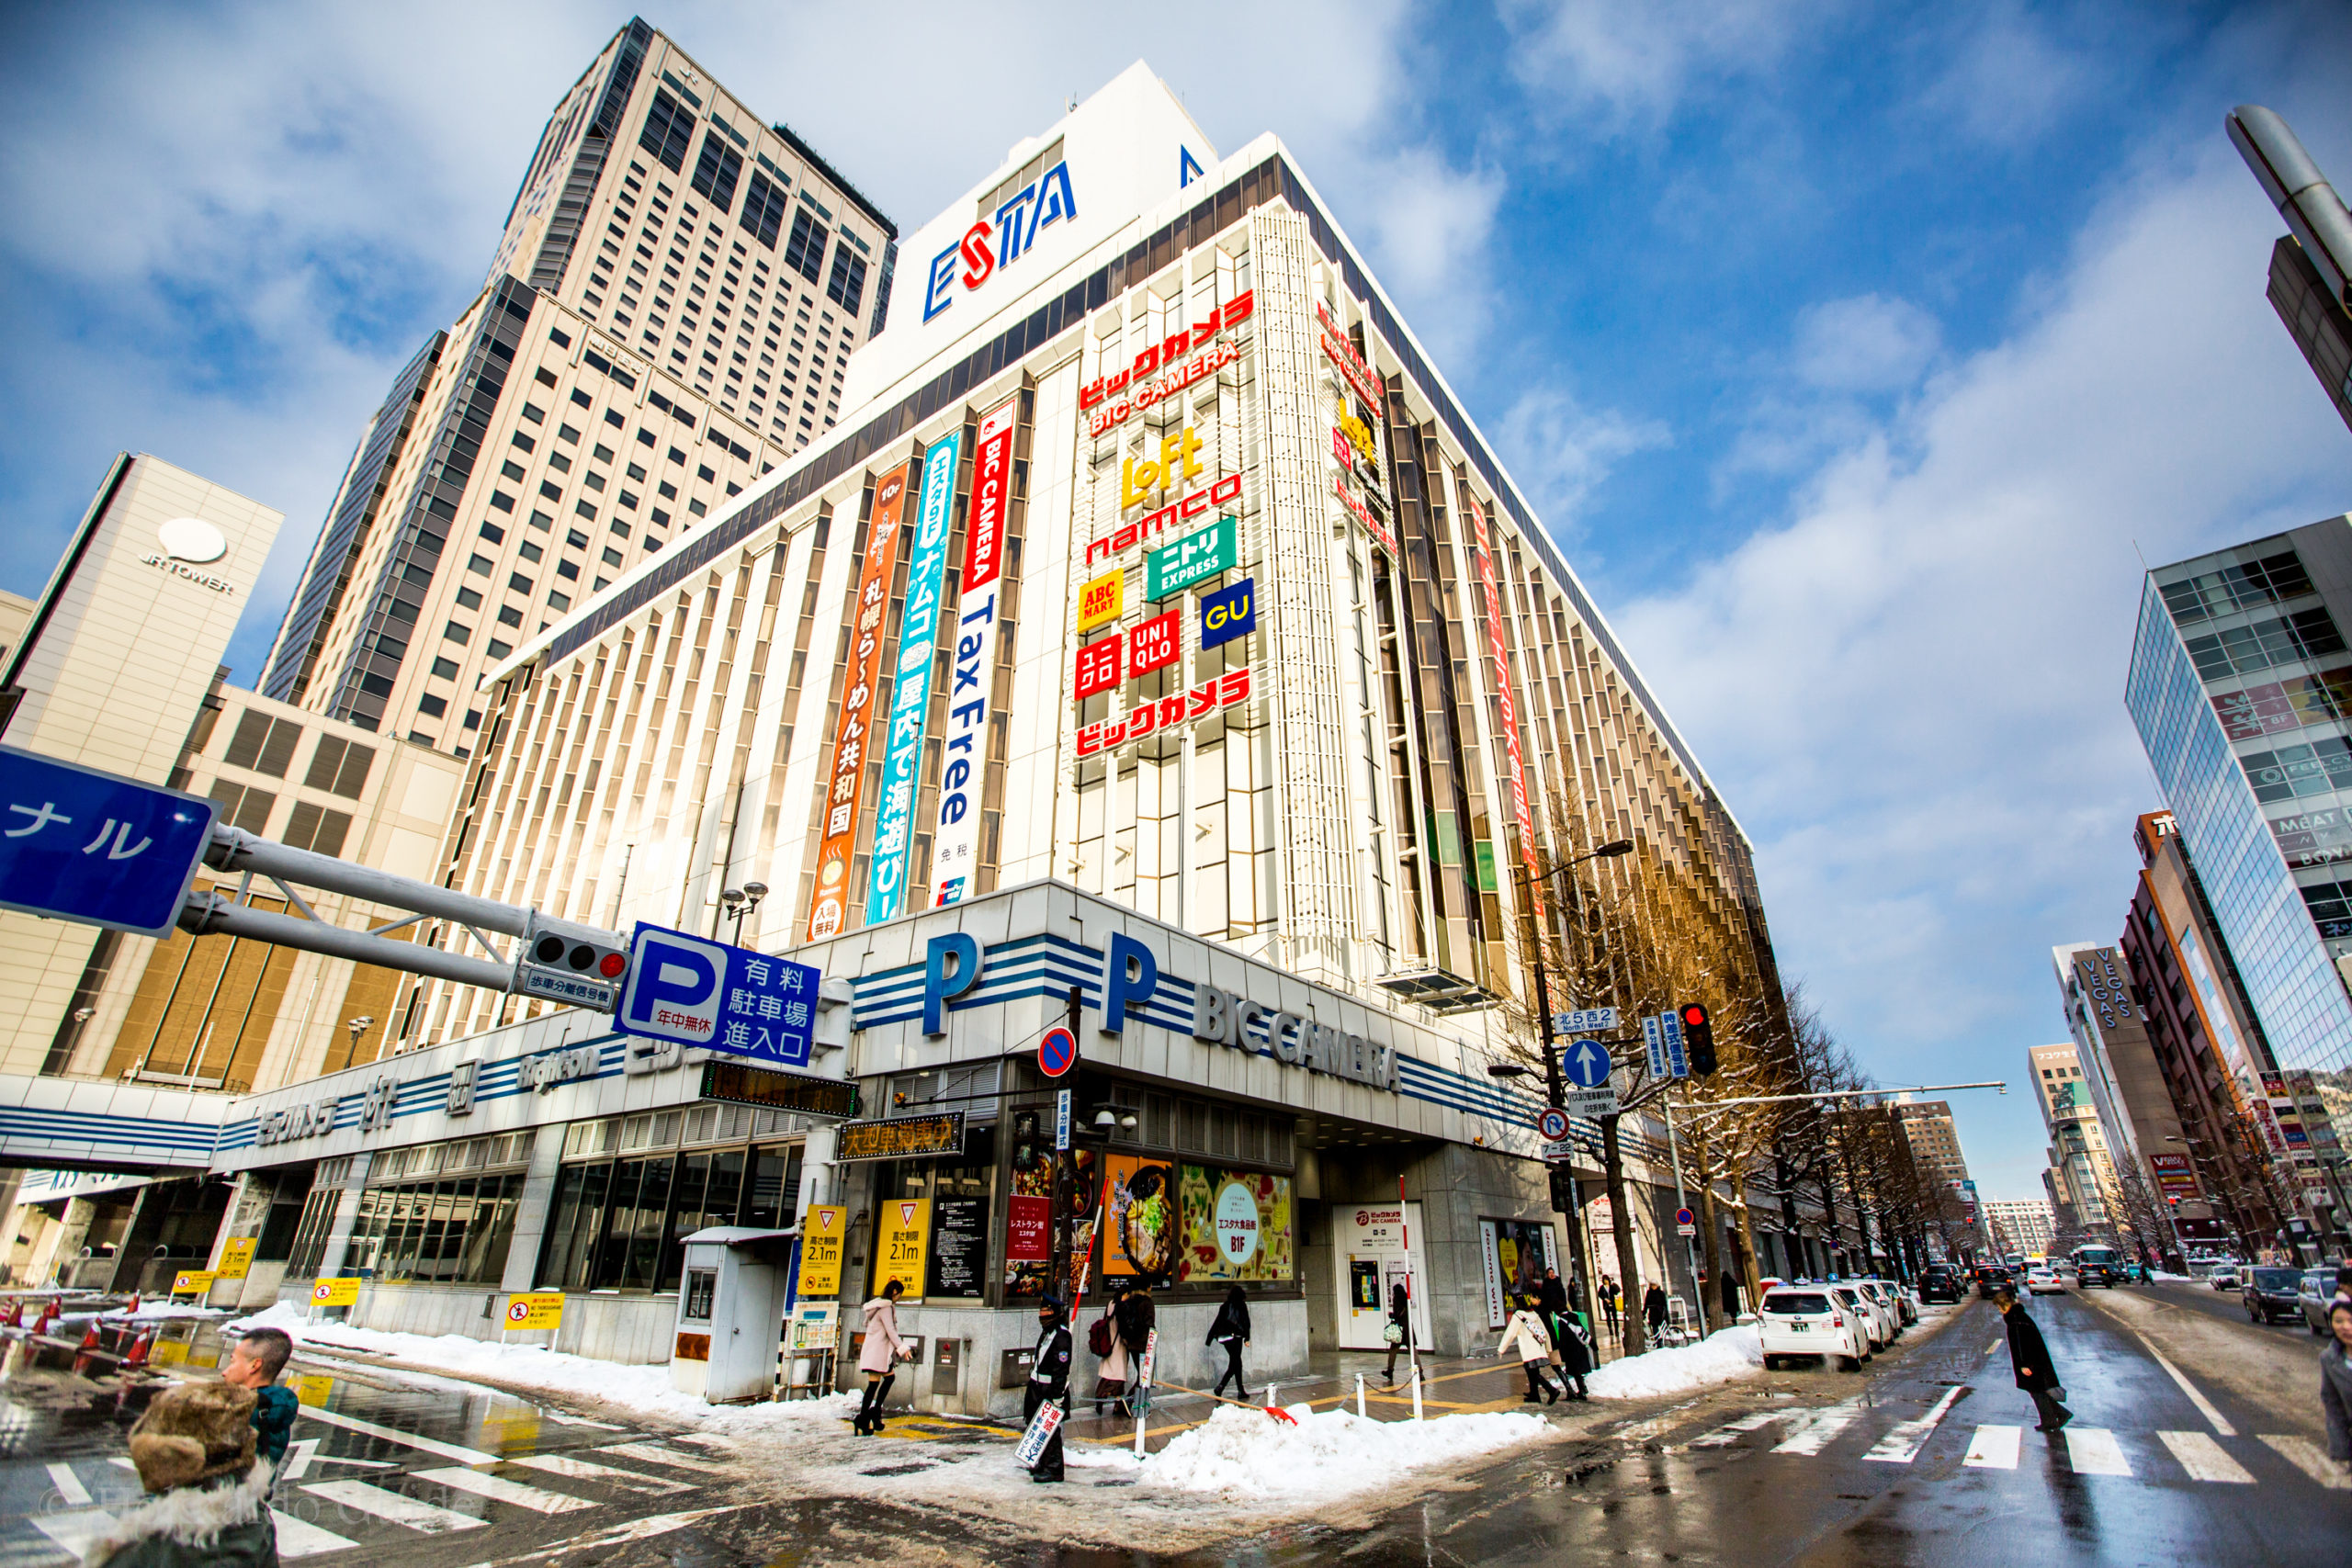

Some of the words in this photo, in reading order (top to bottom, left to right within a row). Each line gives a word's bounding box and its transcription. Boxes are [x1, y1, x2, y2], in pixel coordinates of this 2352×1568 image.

[922, 160, 1078, 324] ESTA
[1080, 288, 1254, 411] ビックカメラ
[1091, 400, 1131, 437] BIC
[1134, 340, 1240, 411] CAMERA
[983, 437, 1002, 479] BIC
[1334, 432, 1347, 453] UNI
[881, 483, 901, 502] 10F
[973, 480, 999, 583] CAMERA
[1086, 473, 1242, 566] namco
[1337, 478, 1397, 556] ビックカメラ
[1161, 527, 1219, 574] ニトリ
[139, 552, 167, 570] JR
[165, 558, 235, 596] TOWER
[1161, 555, 1220, 591] EXPRESS
[909, 550, 940, 638] ナムコ
[1084, 597, 1115, 620] MART
[1085, 581, 1115, 608] ABC
[1205, 594, 1250, 630] GU
[955, 593, 995, 695] Tax
[1135, 639, 1171, 669] QLO
[1136, 621, 1169, 648] UNI
[1080, 663, 1113, 691] クロ
[1082, 644, 1113, 671] ユニ
[1076, 668, 1251, 756] ビックカメラ
[941, 696, 986, 826] Free
[2279, 812, 2335, 833] MEAT
[819, 886, 842, 897] Ramen
[529, 975, 609, 1004] 歩車分離信号機
[628, 939, 718, 1024] P
[744, 957, 805, 996] 有料
[922, 931, 984, 1037] P
[1099, 931, 1159, 1035] P
[2083, 959, 2117, 1028] VEGAS
[2096, 949, 2132, 1018] VEGAS
[656, 1009, 713, 1034] 年中無休
[728, 987, 808, 1029] 駐車場
[721, 1020, 805, 1059] 進入口
[1193, 982, 1264, 1054] BIC
[1269, 1011, 1404, 1094] CAMERA
[1664, 1013, 1686, 1076] 時差式信号機
[1058, 1092, 1069, 1147] 歩車分離式
[809, 1236, 838, 1246] 高さ制限
[892, 1231, 920, 1242] 高さ制限
[1011, 1219, 1045, 1230] レストラン街
[1218, 1219, 1257, 1231] エスタ大食品街
[1231, 1235, 1246, 1253] B1F
[808, 1247, 837, 1260] 2.1m
[890, 1243, 919, 1260] 2.1m
[1485, 1228, 1495, 1284] docomo
[1490, 1286, 1499, 1320] with
